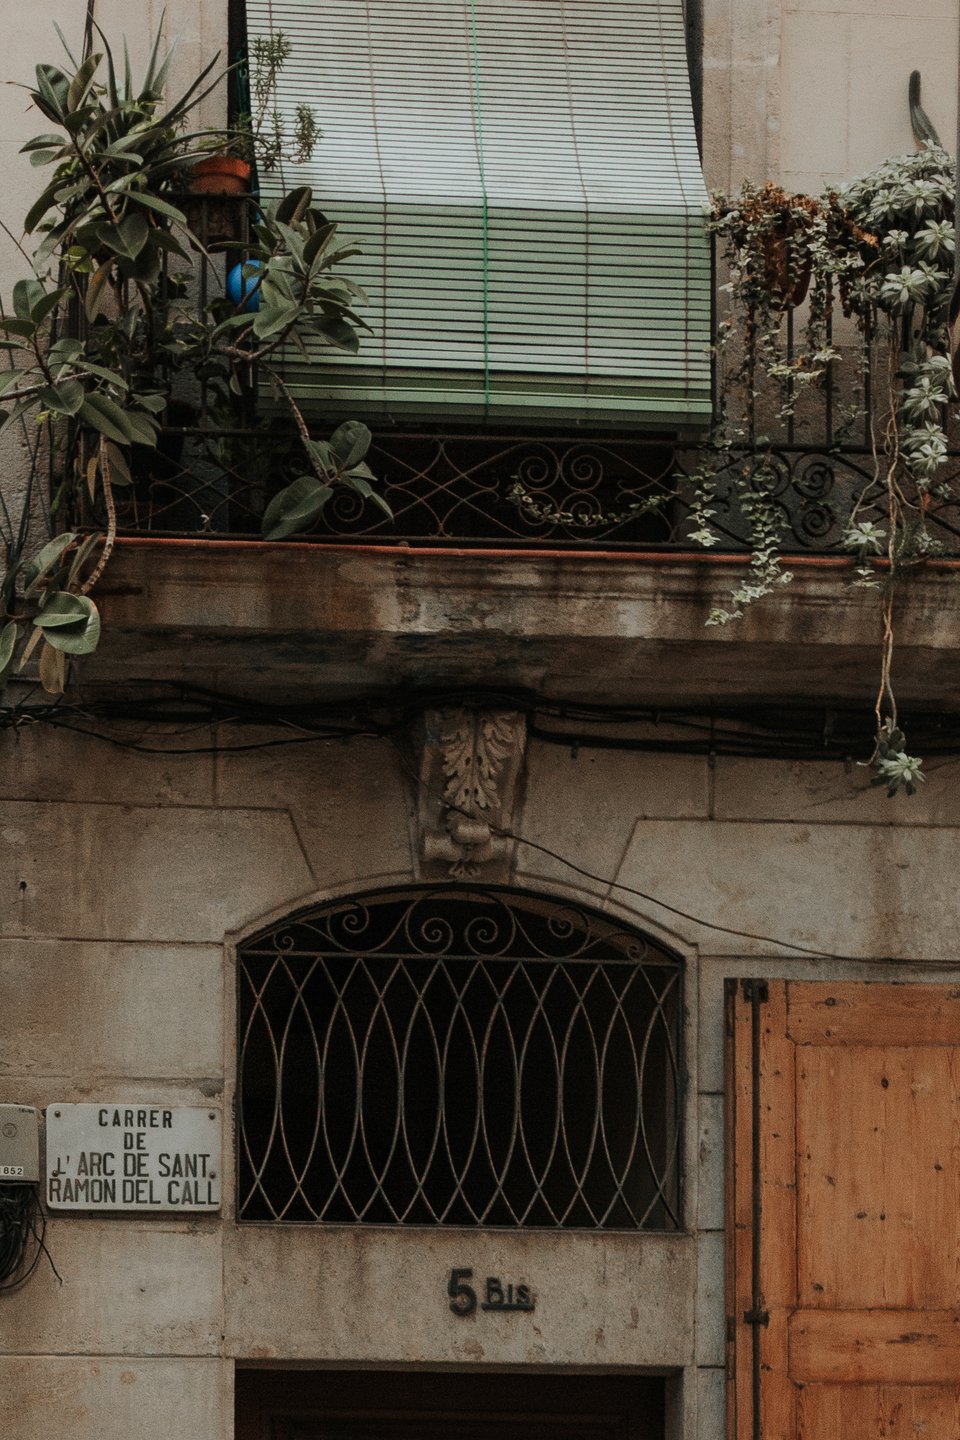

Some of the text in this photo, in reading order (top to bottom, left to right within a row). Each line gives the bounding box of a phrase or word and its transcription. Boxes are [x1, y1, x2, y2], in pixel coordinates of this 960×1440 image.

[99, 1109, 173, 1128] CARRER
[124, 1132, 146, 1150] DE
[124, 1153, 149, 1178] DE
[158, 1153, 210, 1178] SANT
[49, 1178, 219, 1205] RAMON DEL CALL
[447, 1267, 477, 1317] 5
